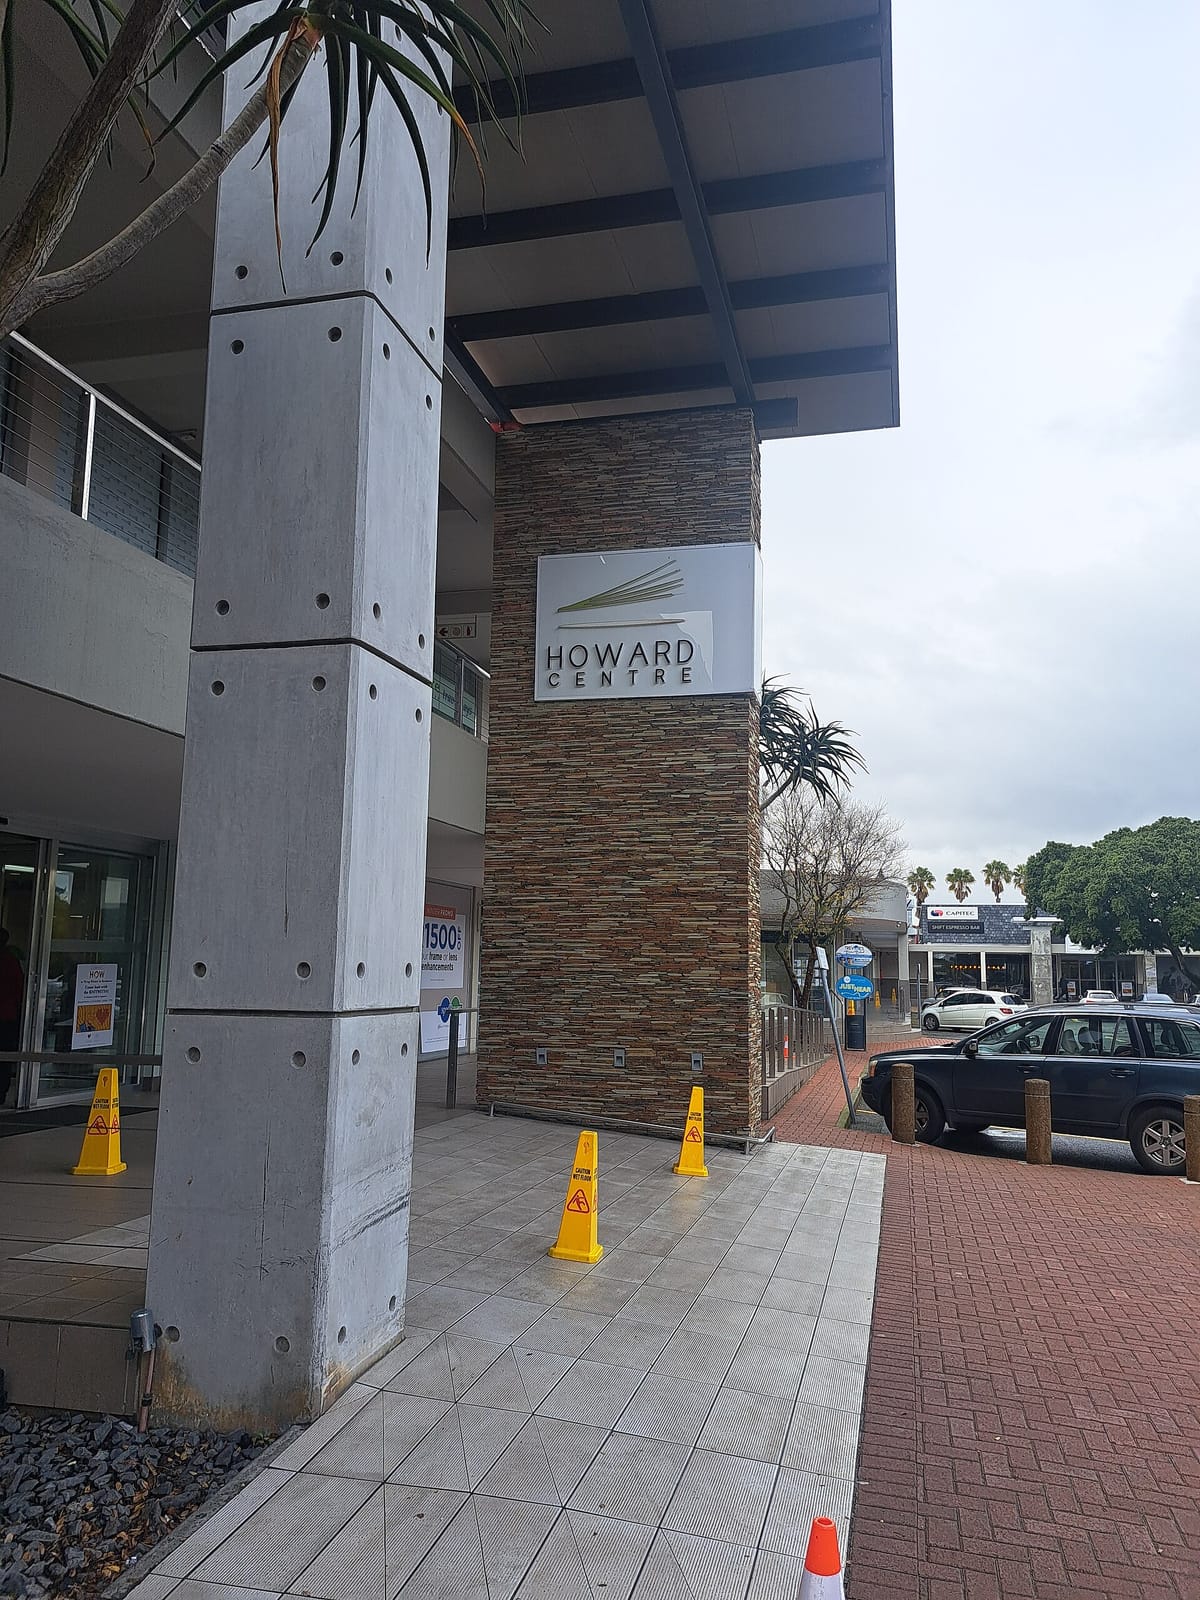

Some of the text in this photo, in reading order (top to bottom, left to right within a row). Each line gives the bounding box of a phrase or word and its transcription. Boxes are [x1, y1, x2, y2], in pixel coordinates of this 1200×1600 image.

[547, 639, 694, 669] HOWARD
[548, 667, 692, 687] CENTRE
[425, 923, 457, 950] 1500
